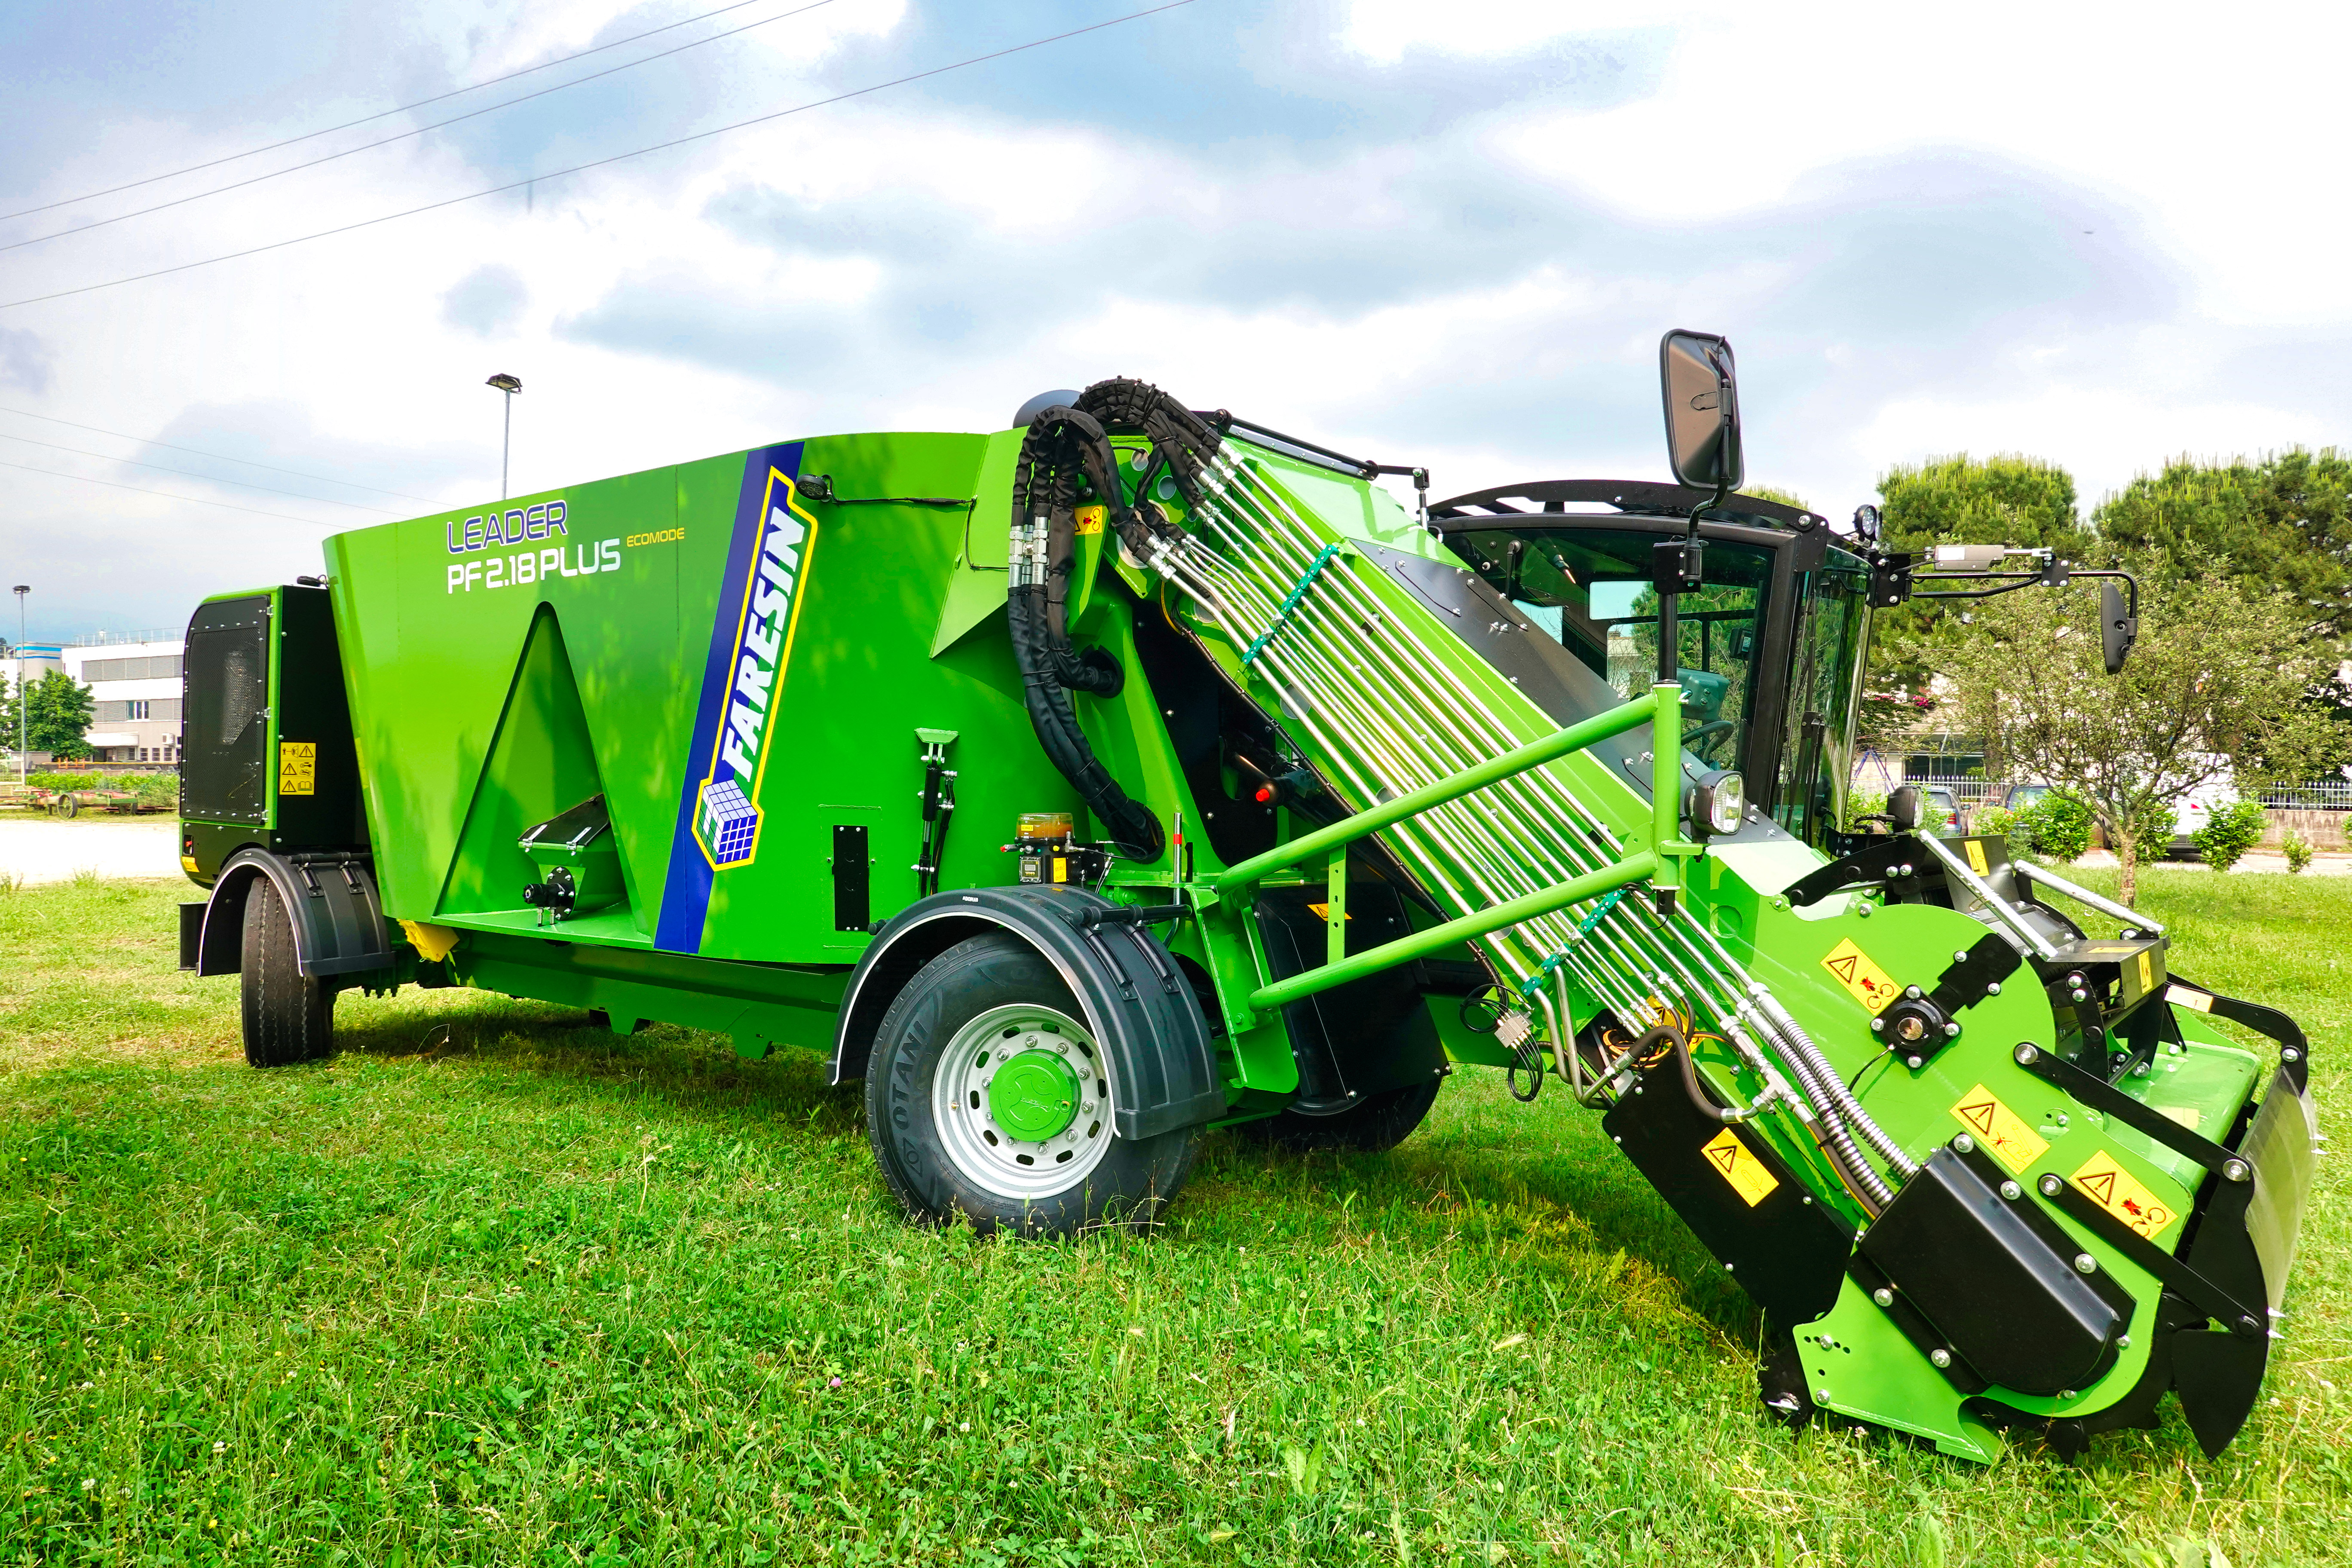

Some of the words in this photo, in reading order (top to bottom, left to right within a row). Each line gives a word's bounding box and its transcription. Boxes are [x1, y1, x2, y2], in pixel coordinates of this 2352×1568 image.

[447, 499, 568, 554] LEADER
[627, 527, 685, 547] ECOMODE
[448, 561, 481, 594] PF
[486, 552, 536, 588] 2.18
[540, 538, 621, 580] PLUS
[722, 506, 805, 782] FARESIN
[892, 1020, 928, 1130] OTANI
